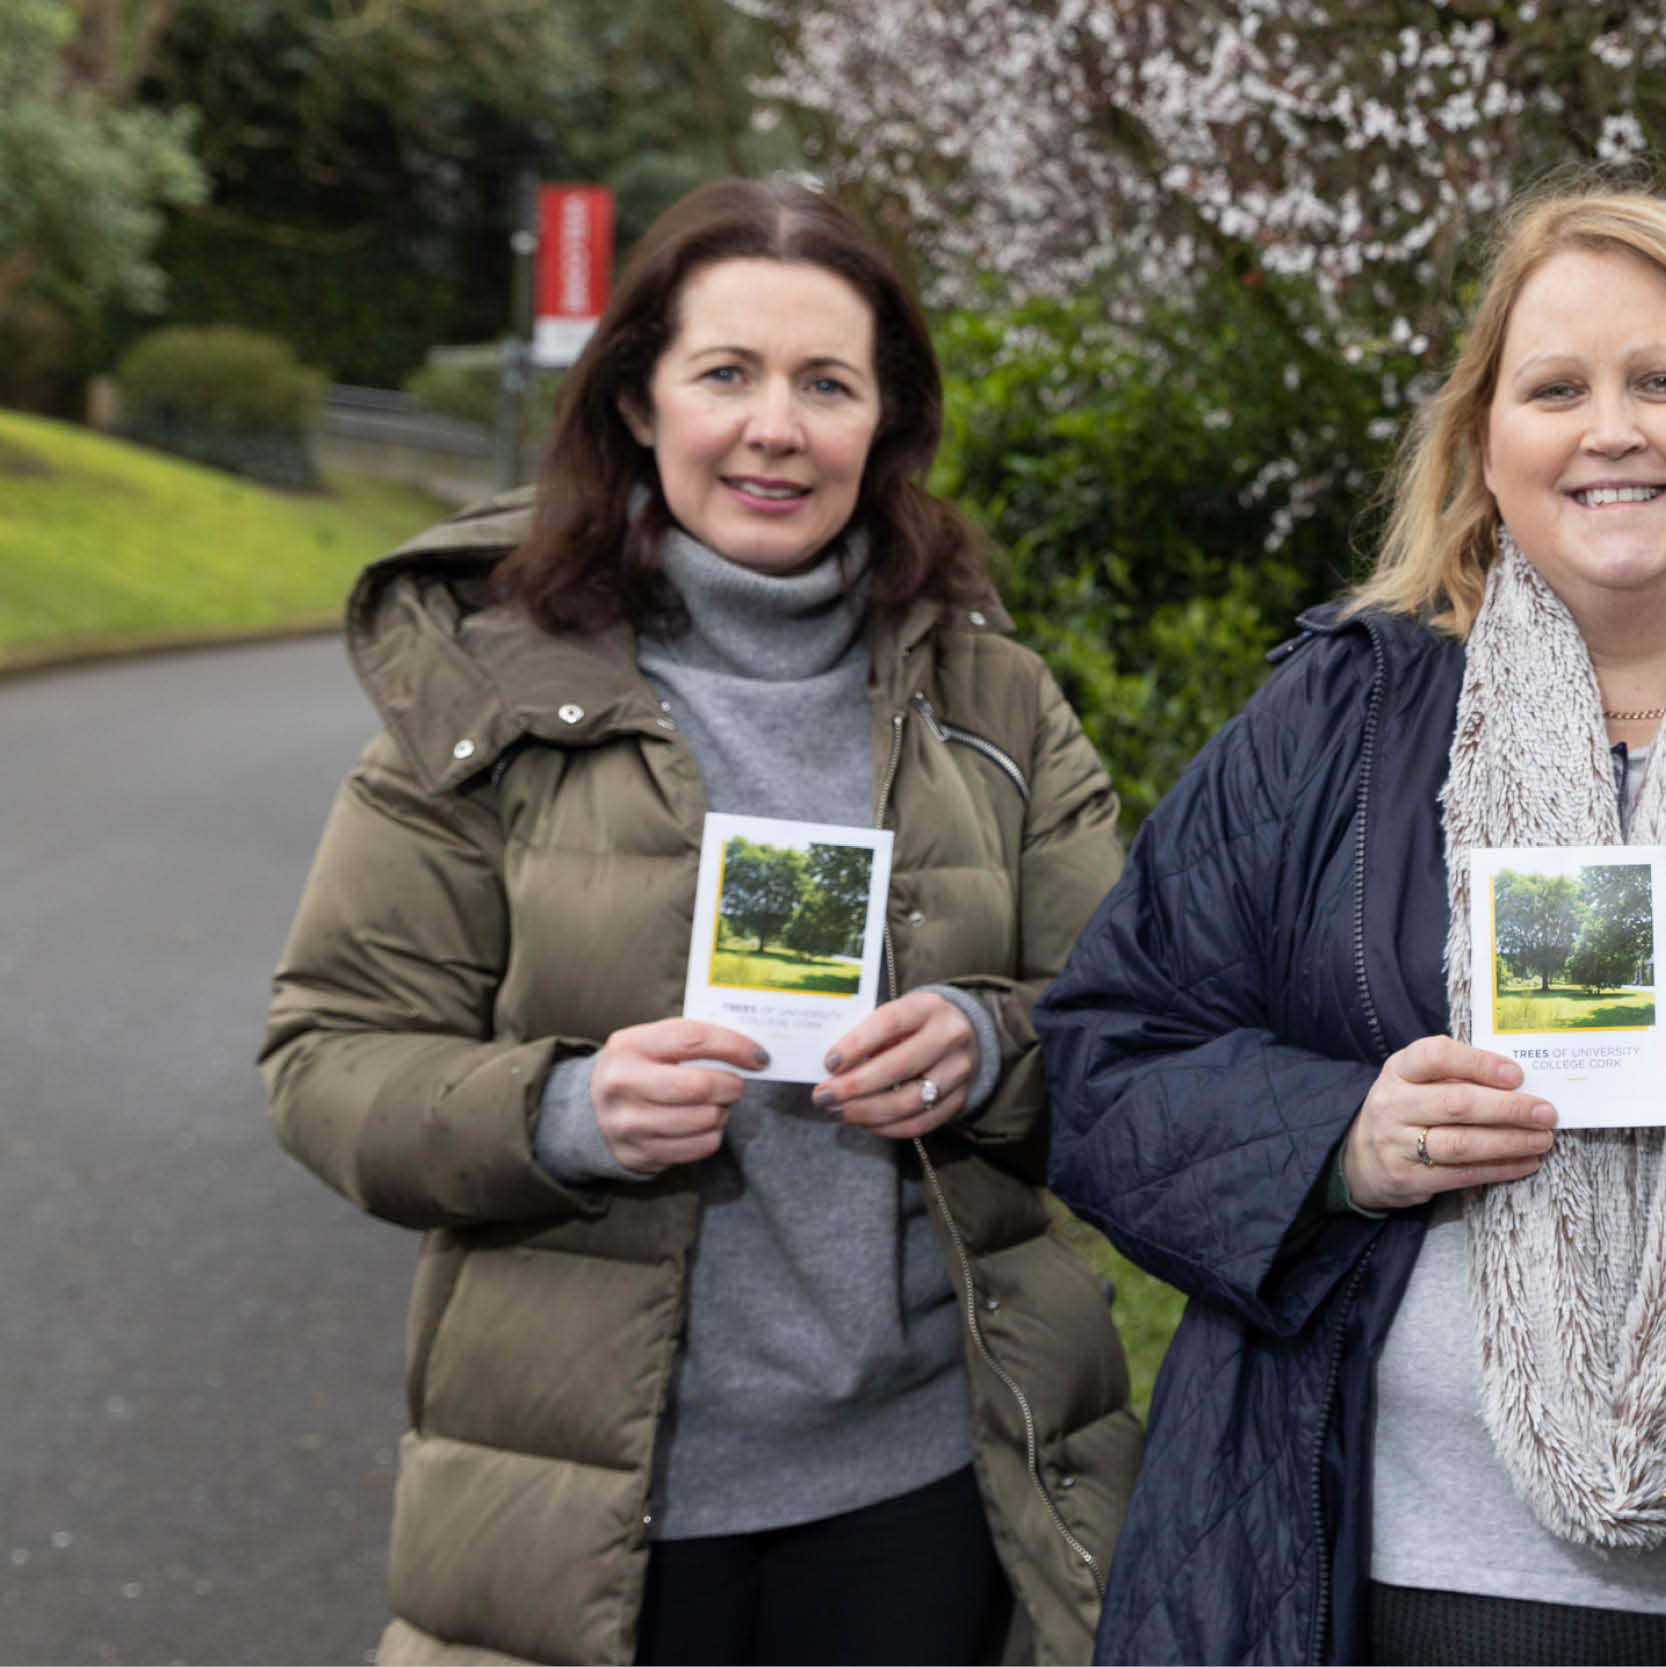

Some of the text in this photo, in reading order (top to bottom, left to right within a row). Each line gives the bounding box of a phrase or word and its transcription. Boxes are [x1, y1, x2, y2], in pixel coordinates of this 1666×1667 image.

[1512, 1046, 1641, 1059] TREES OF UNIVERSITY
[1531, 1058, 1623, 1070] COLLEGE CORK
